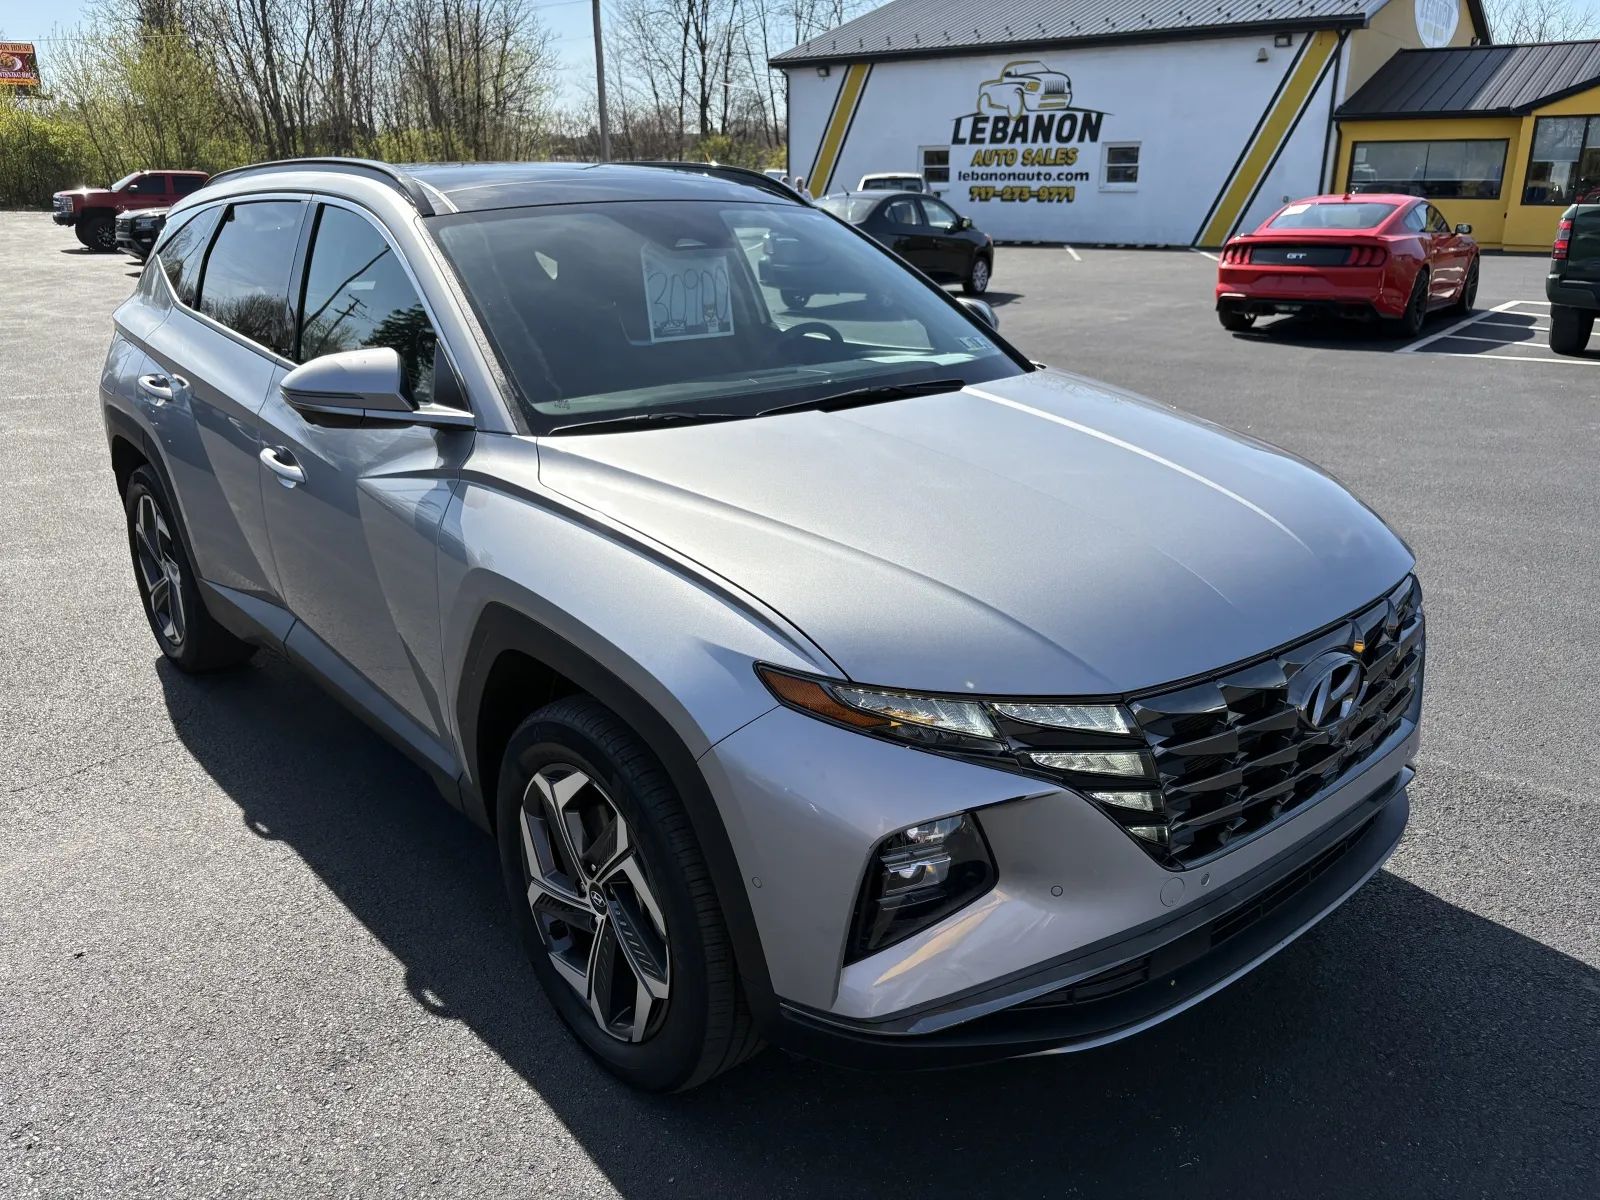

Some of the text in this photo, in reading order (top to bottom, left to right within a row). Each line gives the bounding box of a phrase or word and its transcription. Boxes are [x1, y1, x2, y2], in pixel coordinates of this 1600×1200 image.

[952, 113, 1102, 144] LEBANON
[971, 148, 1078, 167] AUTO SALES
[959, 171, 1089, 181] lebanonauto.com
[969, 186, 1075, 201] 717-273-9771
[1286, 252, 1307, 260] GT
